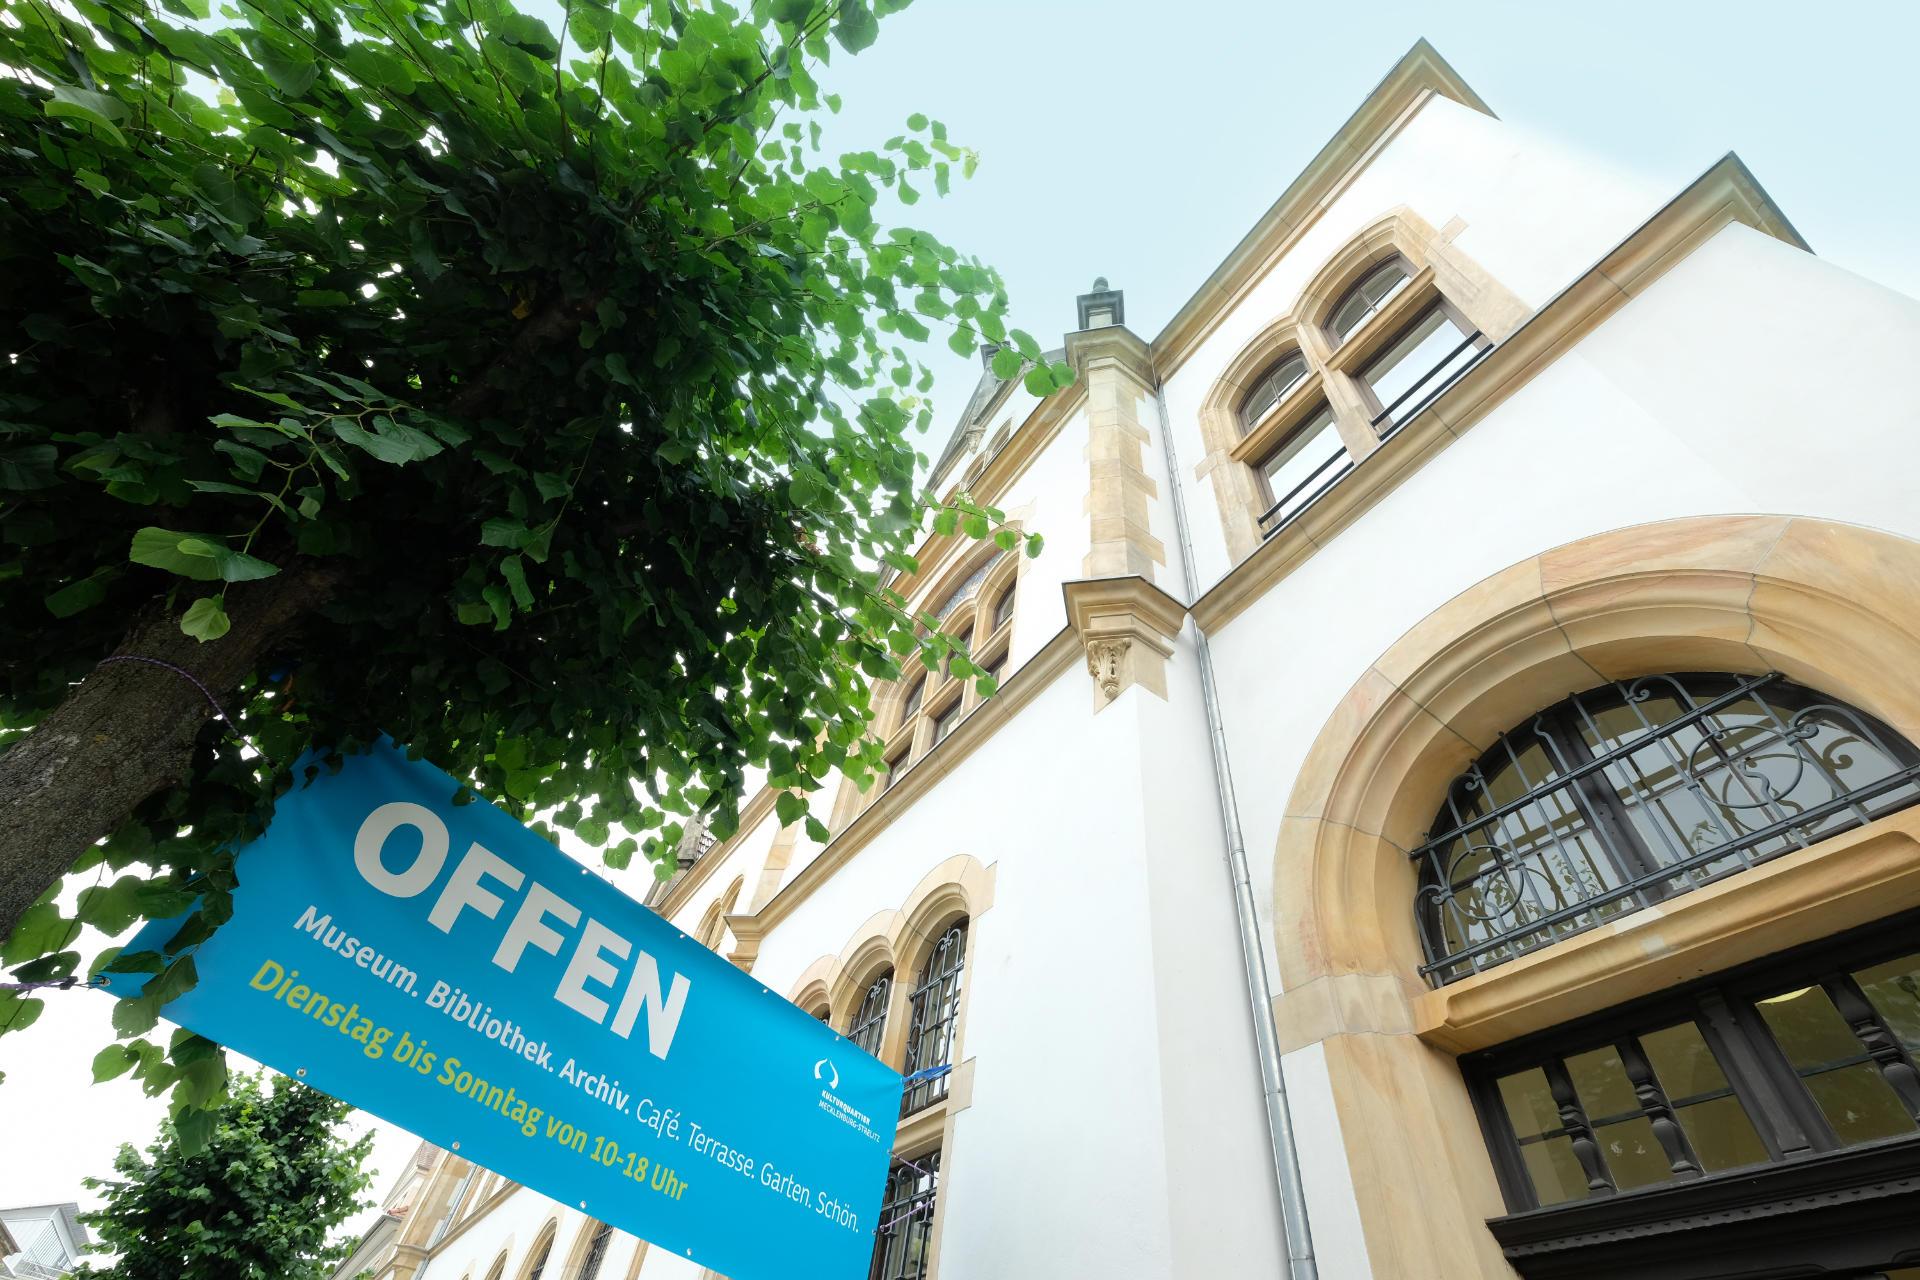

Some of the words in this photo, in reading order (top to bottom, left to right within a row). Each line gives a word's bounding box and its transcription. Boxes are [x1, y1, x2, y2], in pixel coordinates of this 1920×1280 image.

[353, 801, 691, 1061] OFFEN
[249, 959, 393, 1059] Dienstag
[392, 1031, 437, 1075] bis
[436, 1057, 544, 1137] Sonntag
[546, 1115, 588, 1153] von
[590, 1136, 649, 1182] 10-18
[651, 1164, 688, 1201] Uhr
[293, 905, 419, 997] Museum.
[425, 980, 554, 1073] Bibliothek.
[558, 1058, 630, 1114] Archiv.
[637, 1098, 681, 1141] Café.
[688, 1122, 755, 1179] Terrasse.
[760, 1162, 812, 1209] Garten.
[815, 1192, 860, 1233] Schön.
[818, 1099, 881, 1143] MECKLENBURG-STRELITZ
[821, 1089, 871, 1126] KULTURQUARTIER
